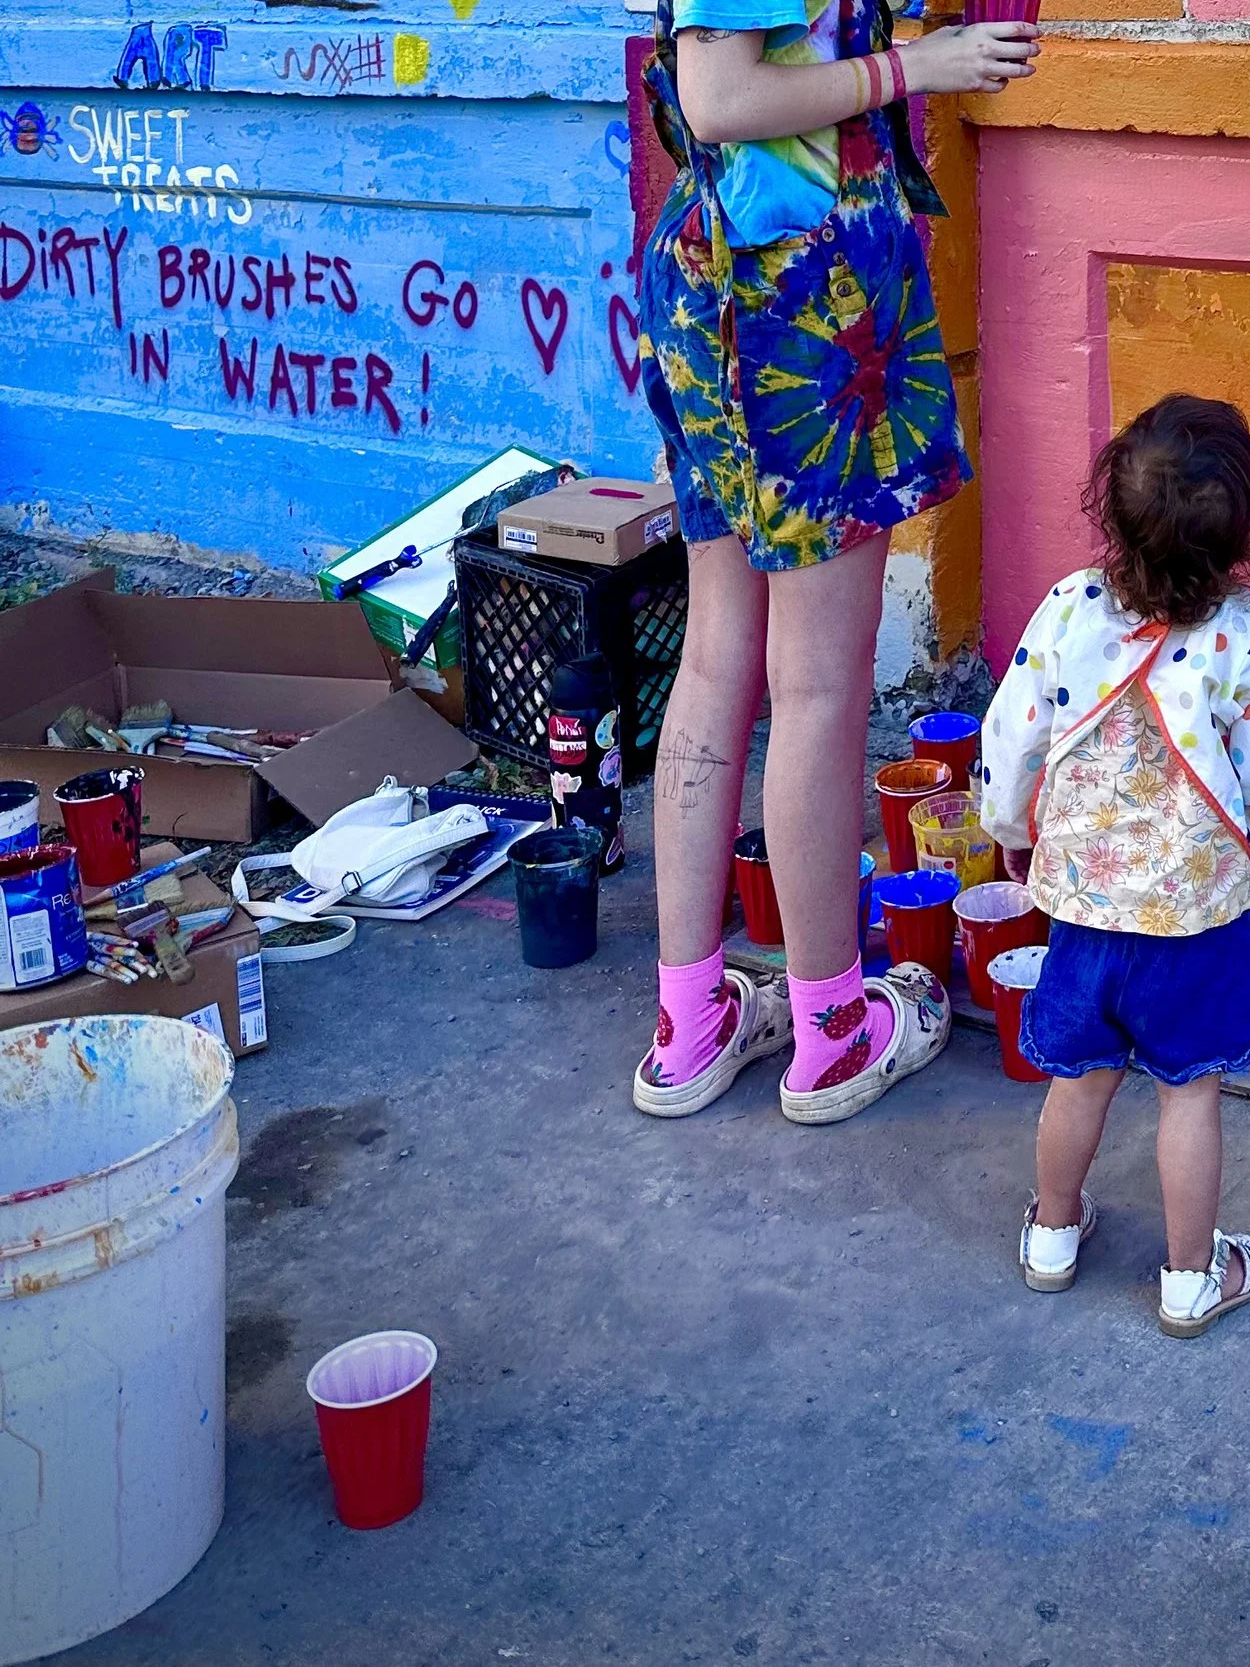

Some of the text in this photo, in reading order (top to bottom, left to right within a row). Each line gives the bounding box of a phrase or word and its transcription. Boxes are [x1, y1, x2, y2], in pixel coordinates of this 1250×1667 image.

[112, 20, 229, 92] ART
[67, 104, 190, 166] SWEET
[92, 162, 253, 226] TREATS
[157, 244, 359, 320] BRUSHES
[129, 327, 169, 385] IN
